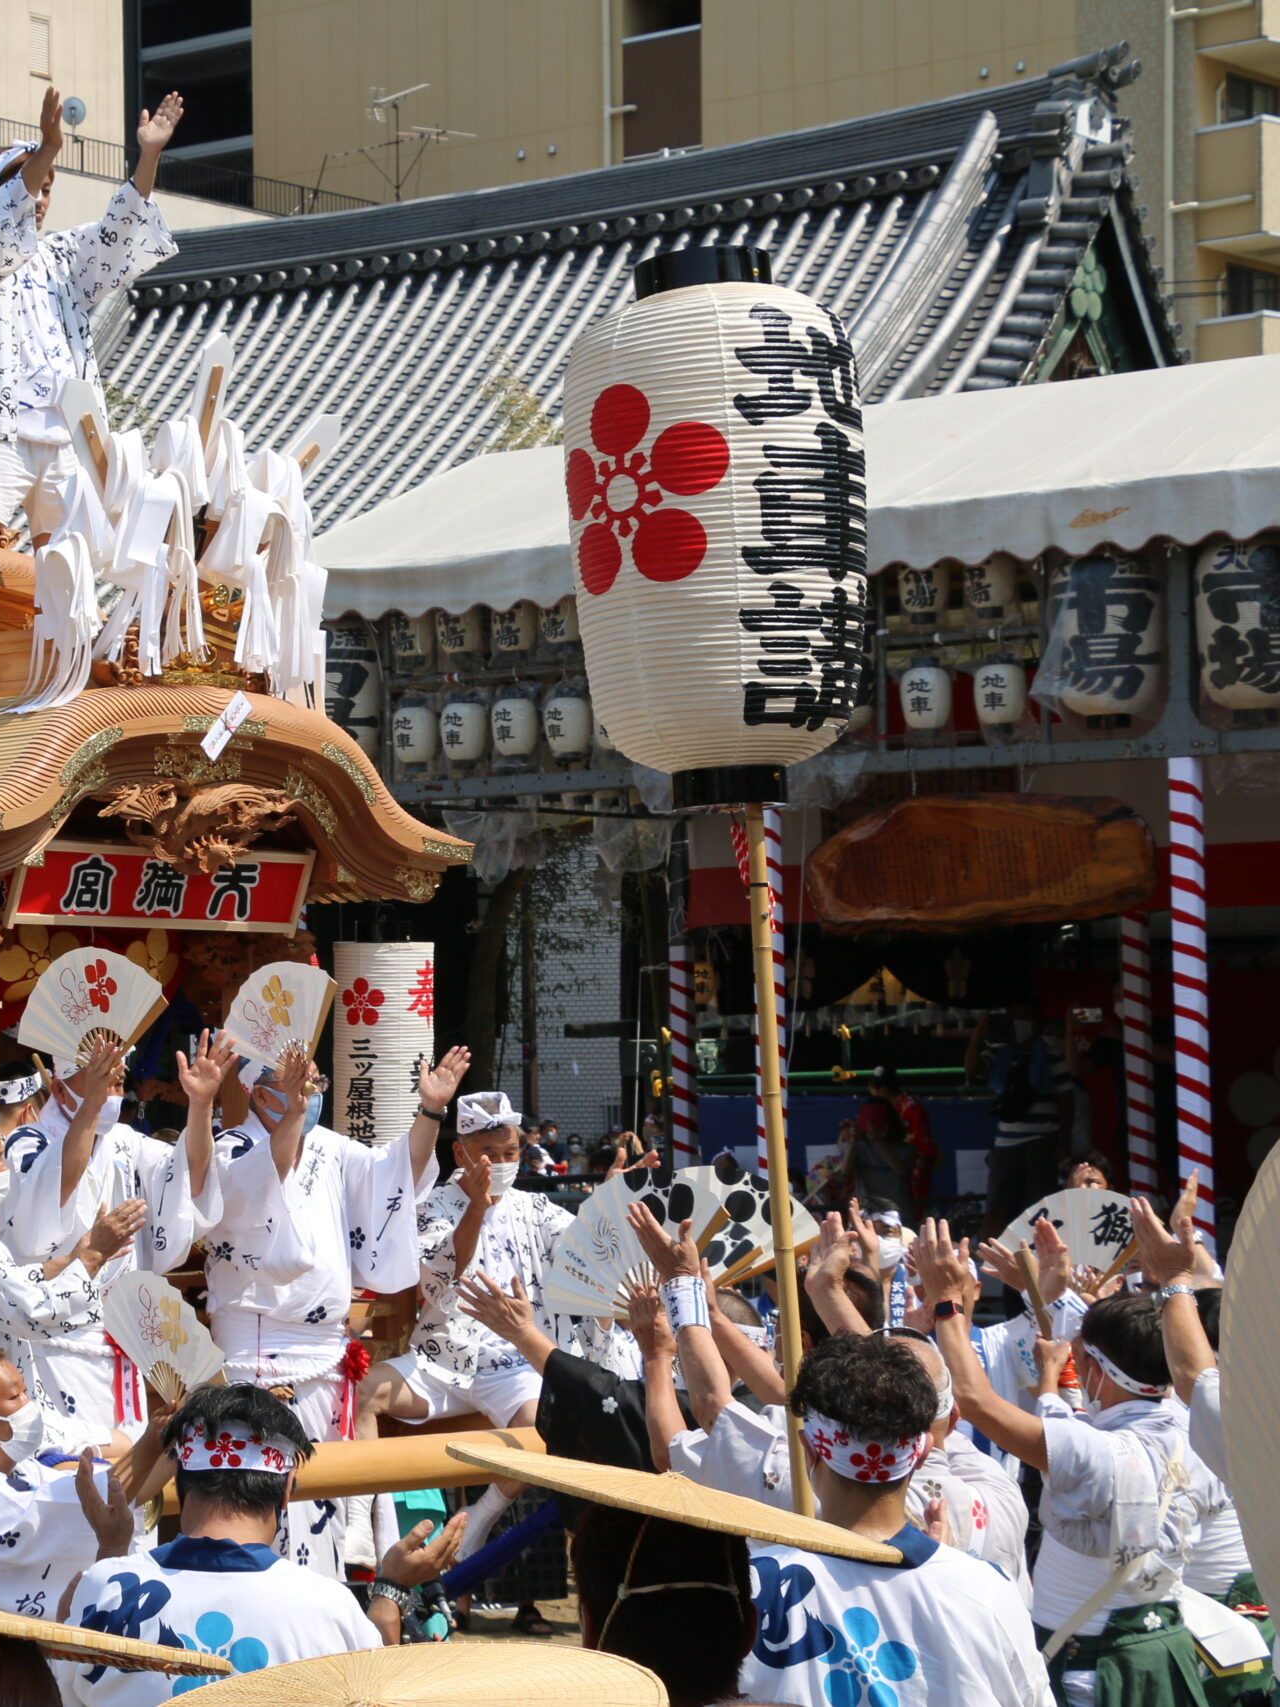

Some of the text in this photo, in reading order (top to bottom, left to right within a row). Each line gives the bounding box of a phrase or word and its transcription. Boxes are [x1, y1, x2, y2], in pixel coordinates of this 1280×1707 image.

[907, 678, 932, 716] 地車
[981, 674, 1006, 710] 地車
[394, 717, 414, 750] 地車
[444, 712, 464, 749] 地車
[494, 708, 515, 743] 地車
[546, 708, 565, 740] 地車
[59, 853, 261, 921] 天満宮
[406, 960, 435, 1029] 奉
